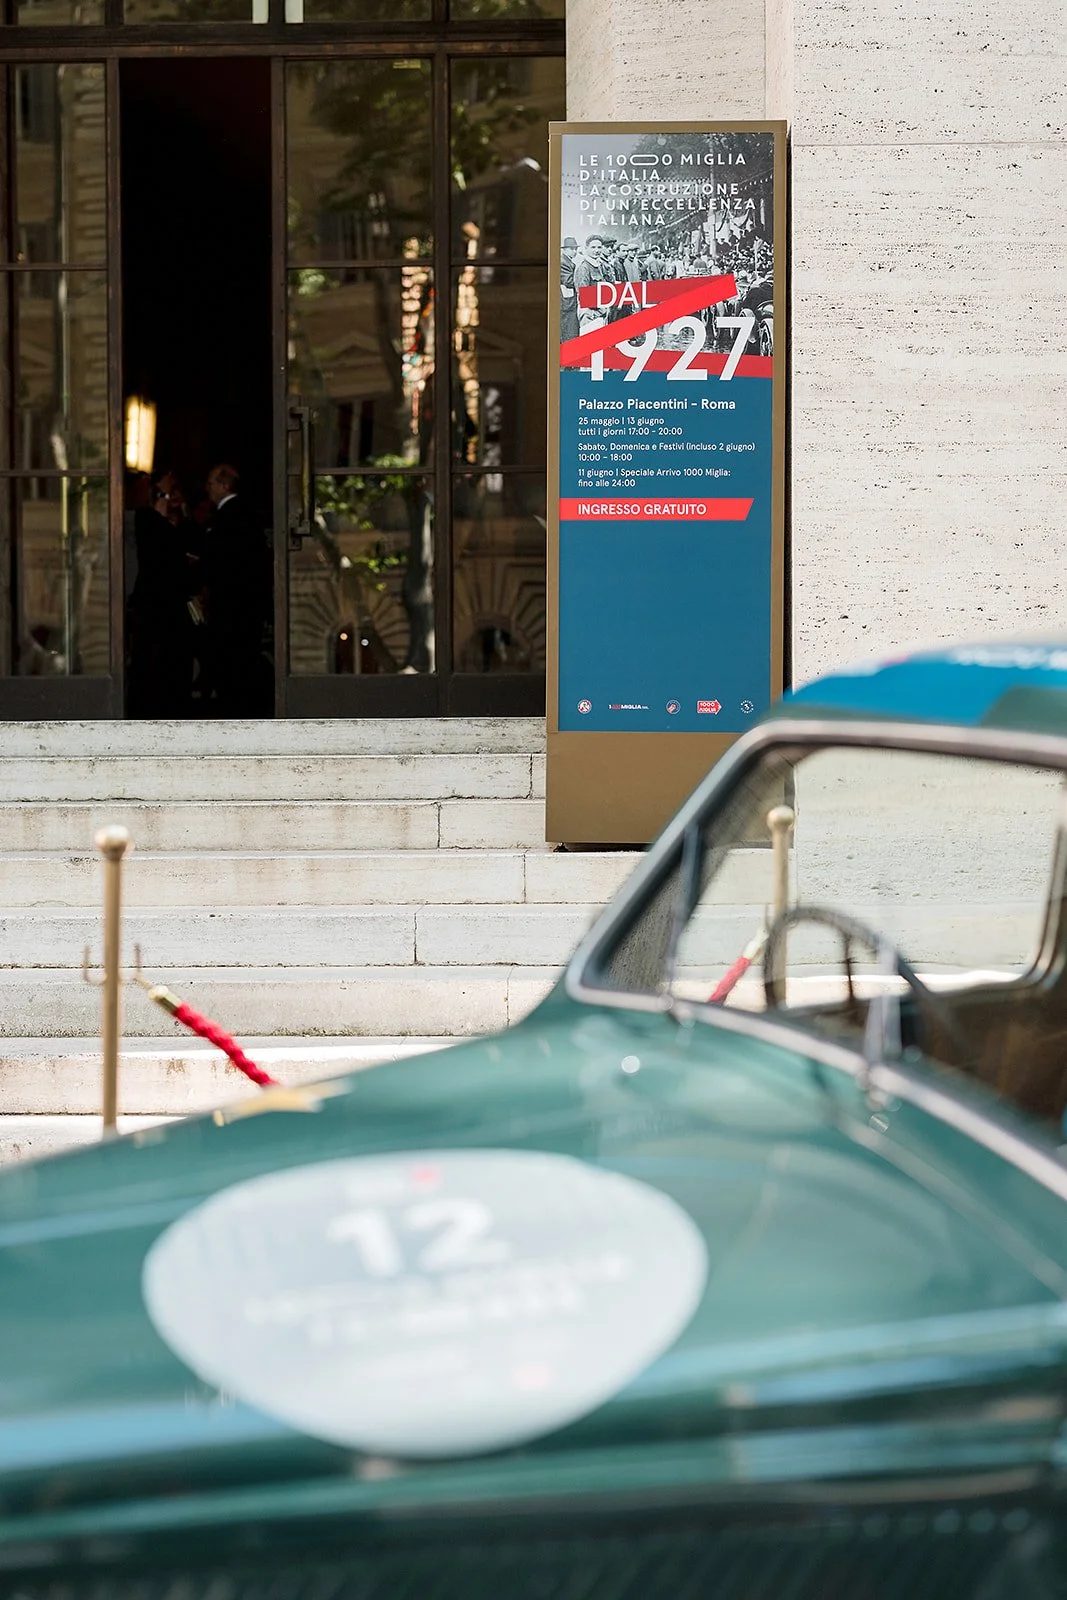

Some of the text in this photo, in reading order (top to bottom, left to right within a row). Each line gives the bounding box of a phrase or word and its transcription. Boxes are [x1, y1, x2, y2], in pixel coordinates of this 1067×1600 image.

[580, 155, 598, 166] LE
[681, 154, 746, 165] MIGLIA
[580, 169, 660, 181] D'ITALIA
[580, 183, 739, 196] LA COSTRUZIONE
[580, 198, 756, 211] DI UN'ECCELLENZA
[580, 214, 666, 225] ITALIANA
[597, 281, 659, 308] DAL
[578, 399, 623, 409] Palazzo
[627, 399, 688, 409] Piacentini
[701, 399, 735, 409] Roma
[578, 417, 588, 425] 25
[591, 418, 619, 426] maggio
[638, 417, 664, 426] giugno
[603, 428, 626, 437] giorni
[578, 443, 608, 451] Sabato,
[687, 442, 716, 451] (incluso
[726, 443, 755, 452] giugno)
[587, 469, 613, 478] giugno
[621, 469, 654, 477] Speciale
[706, 469, 731, 478] Miglia:
[578, 479, 593, 487] fino
[578, 504, 706, 515] INGRESSO GRATUITO
[327, 1198, 512, 1277] 12
